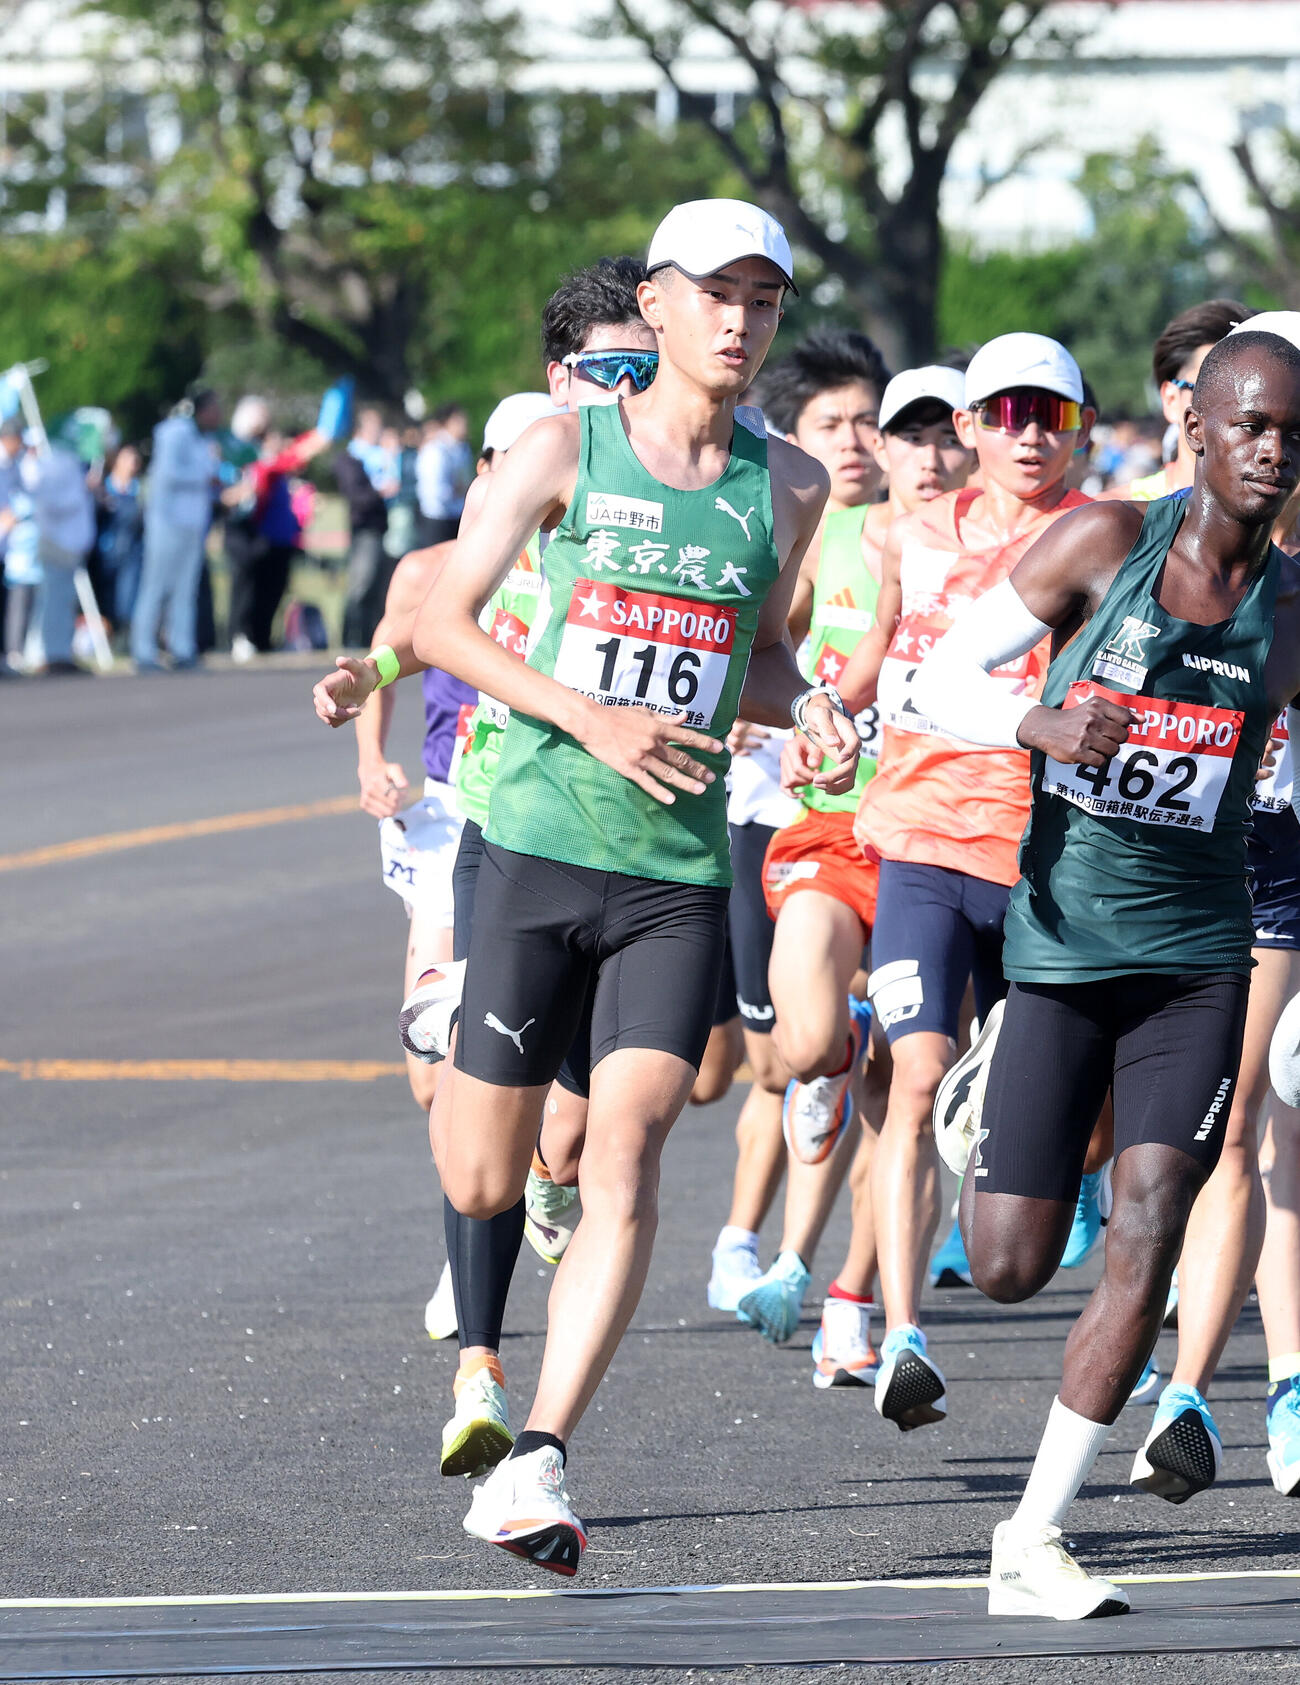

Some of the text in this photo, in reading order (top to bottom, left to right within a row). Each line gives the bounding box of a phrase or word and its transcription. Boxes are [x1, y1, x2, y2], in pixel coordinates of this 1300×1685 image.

[580, 529, 752, 596] 東京農大
[610, 600, 730, 643] SAPPORO
[596, 637, 702, 706] 116
[1182, 653, 1250, 683] KIPRUN
[1129, 708, 1234, 747] PPORO
[1056, 782, 1204, 826] 第103回箱根駅伝予選会
[1076, 751, 1197, 811] 462
[1194, 1078, 1231, 1141] KIPRUN
